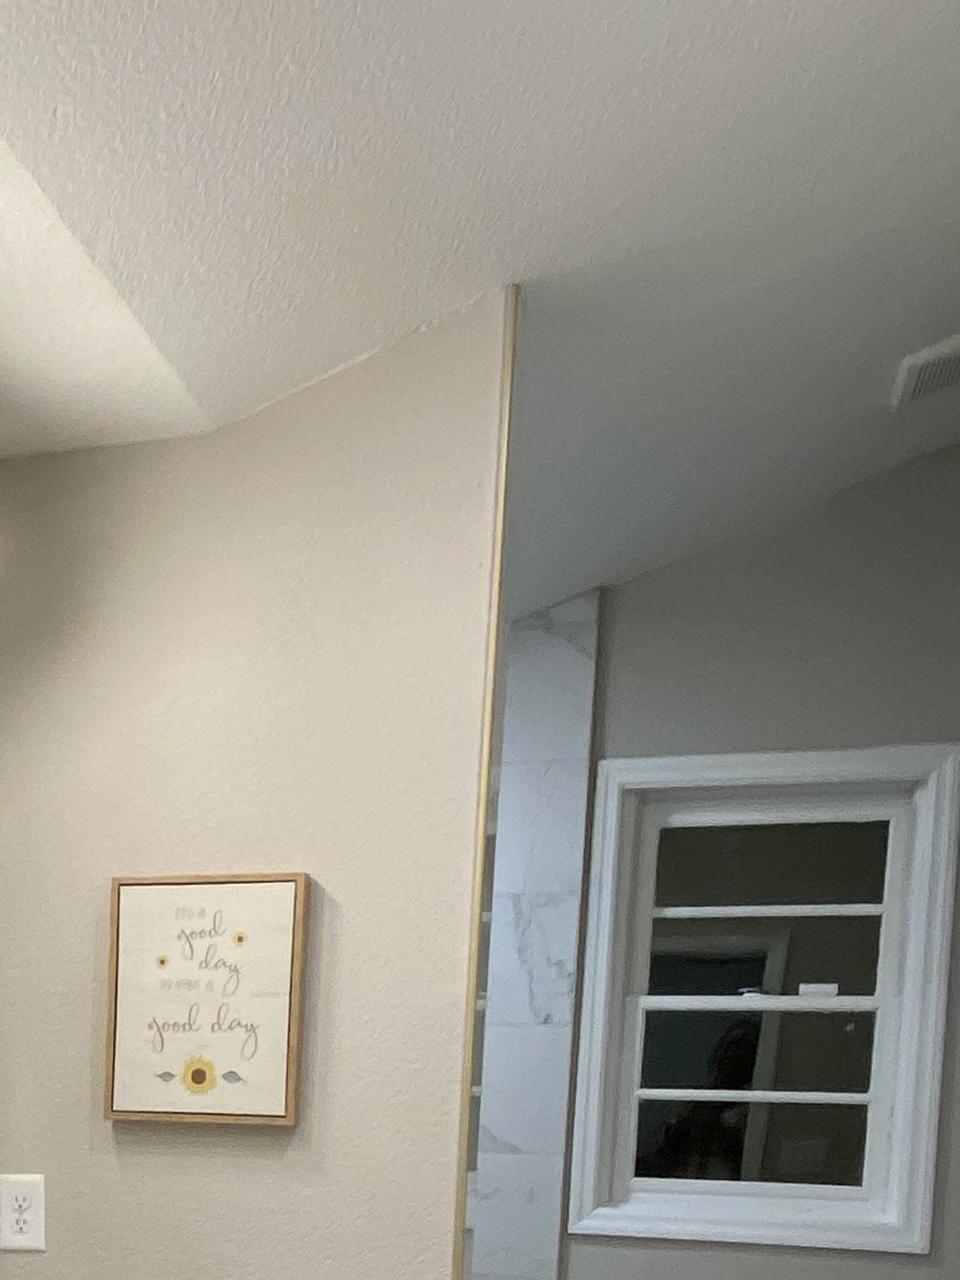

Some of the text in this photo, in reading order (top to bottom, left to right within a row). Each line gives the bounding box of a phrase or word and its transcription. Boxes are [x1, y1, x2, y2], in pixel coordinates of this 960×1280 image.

[176, 909, 227, 960] good
[198, 943, 242, 998] day
[147, 1002, 259, 1061] good day
